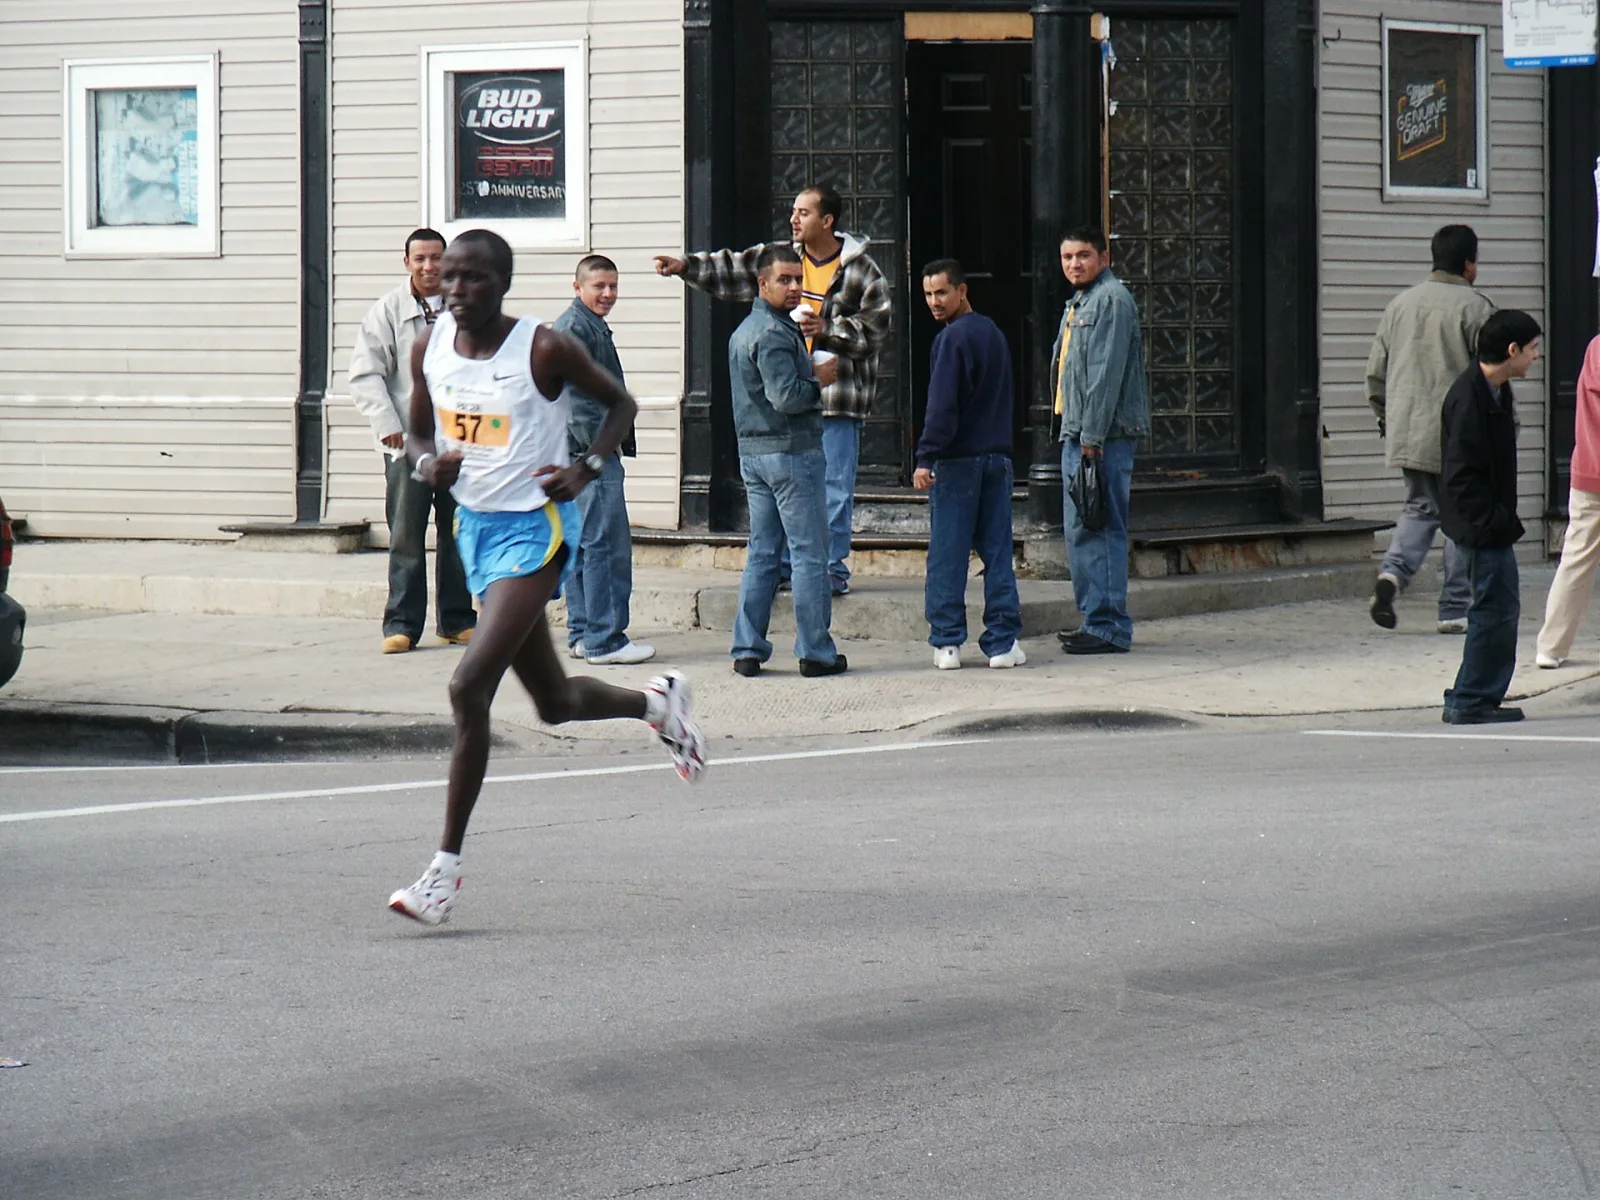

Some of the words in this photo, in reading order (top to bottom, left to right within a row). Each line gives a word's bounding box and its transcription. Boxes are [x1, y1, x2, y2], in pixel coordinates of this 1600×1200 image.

[478, 89, 542, 108] BUD
[466, 109, 555, 128] LIGHT
[1396, 97, 1447, 131] GENUINE
[1403, 117, 1439, 144] DRAFT
[456, 414, 482, 443] 57
